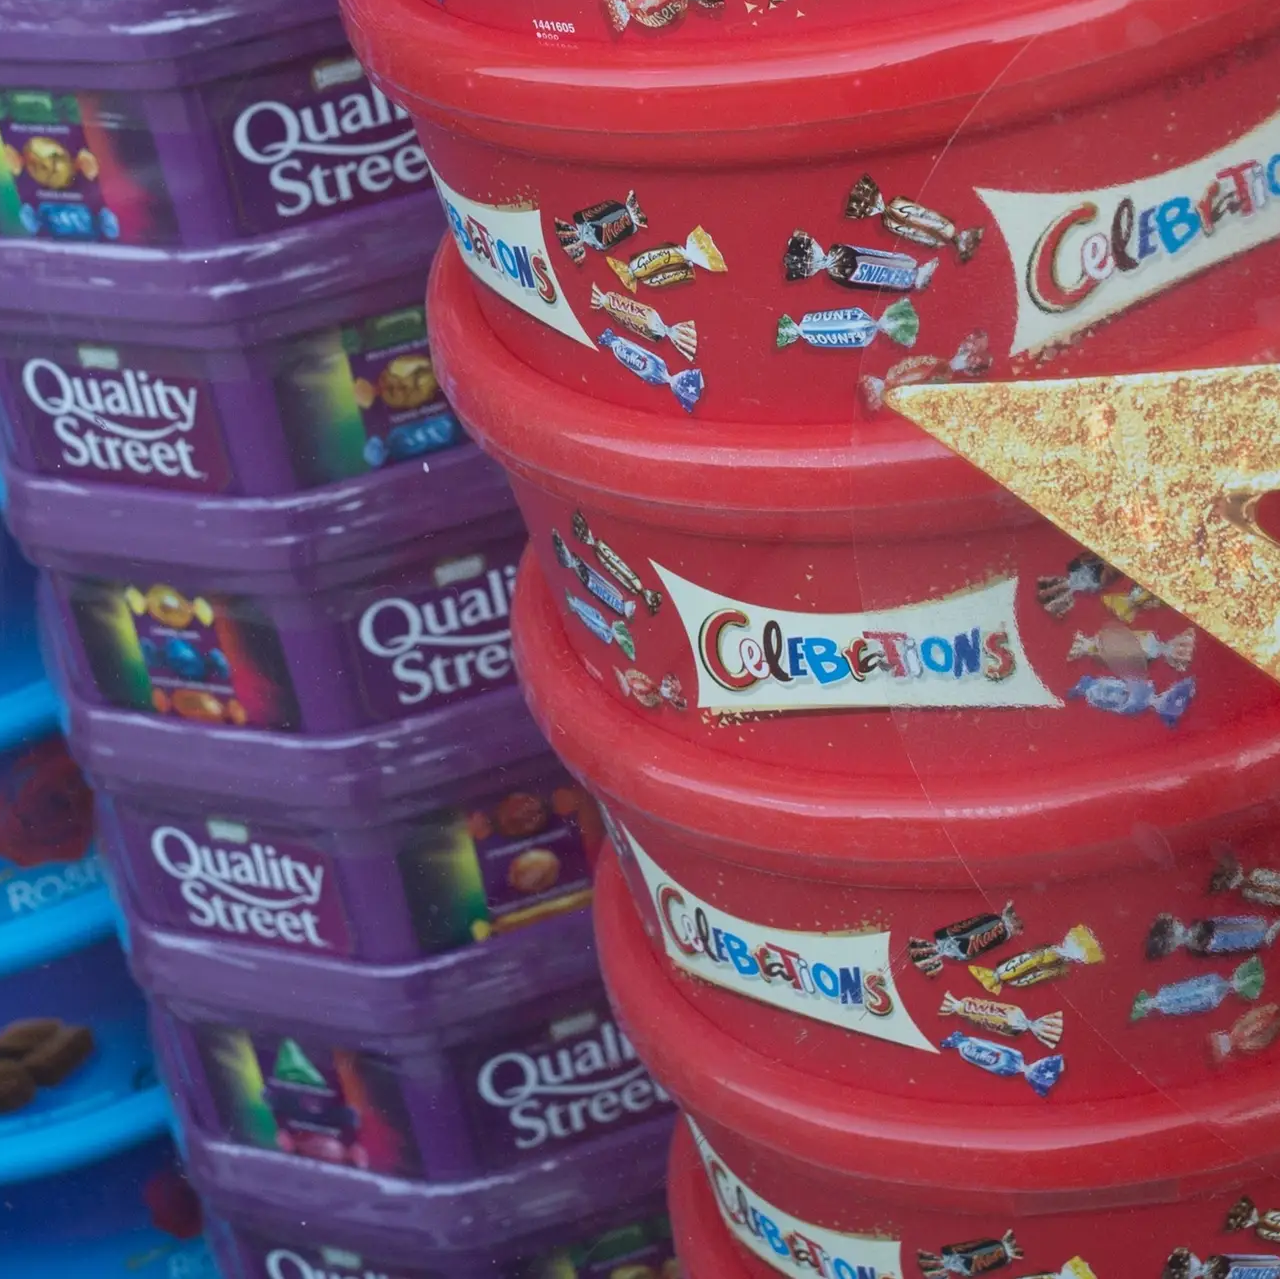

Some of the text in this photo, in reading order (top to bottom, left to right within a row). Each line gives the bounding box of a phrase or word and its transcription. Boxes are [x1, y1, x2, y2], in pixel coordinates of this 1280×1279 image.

[533, 20, 575, 33] 1441605
[233, 80, 410, 165] Quali
[269, 138, 430, 217] Stree
[637, 250, 671, 270] Galaxy
[856, 265, 913, 285] SNICKERS
[803, 310, 863, 323] BOUNTY
[808, 331, 867, 346] BOUNTY
[23, 356, 198, 438] Quality
[53, 415, 202, 478] Street
[357, 570, 517, 660] Quali
[390, 630, 515, 705] Stre
[151, 825, 323, 905] Quality
[181, 880, 327, 945] Street
[968, 923, 1004, 954] Mars
